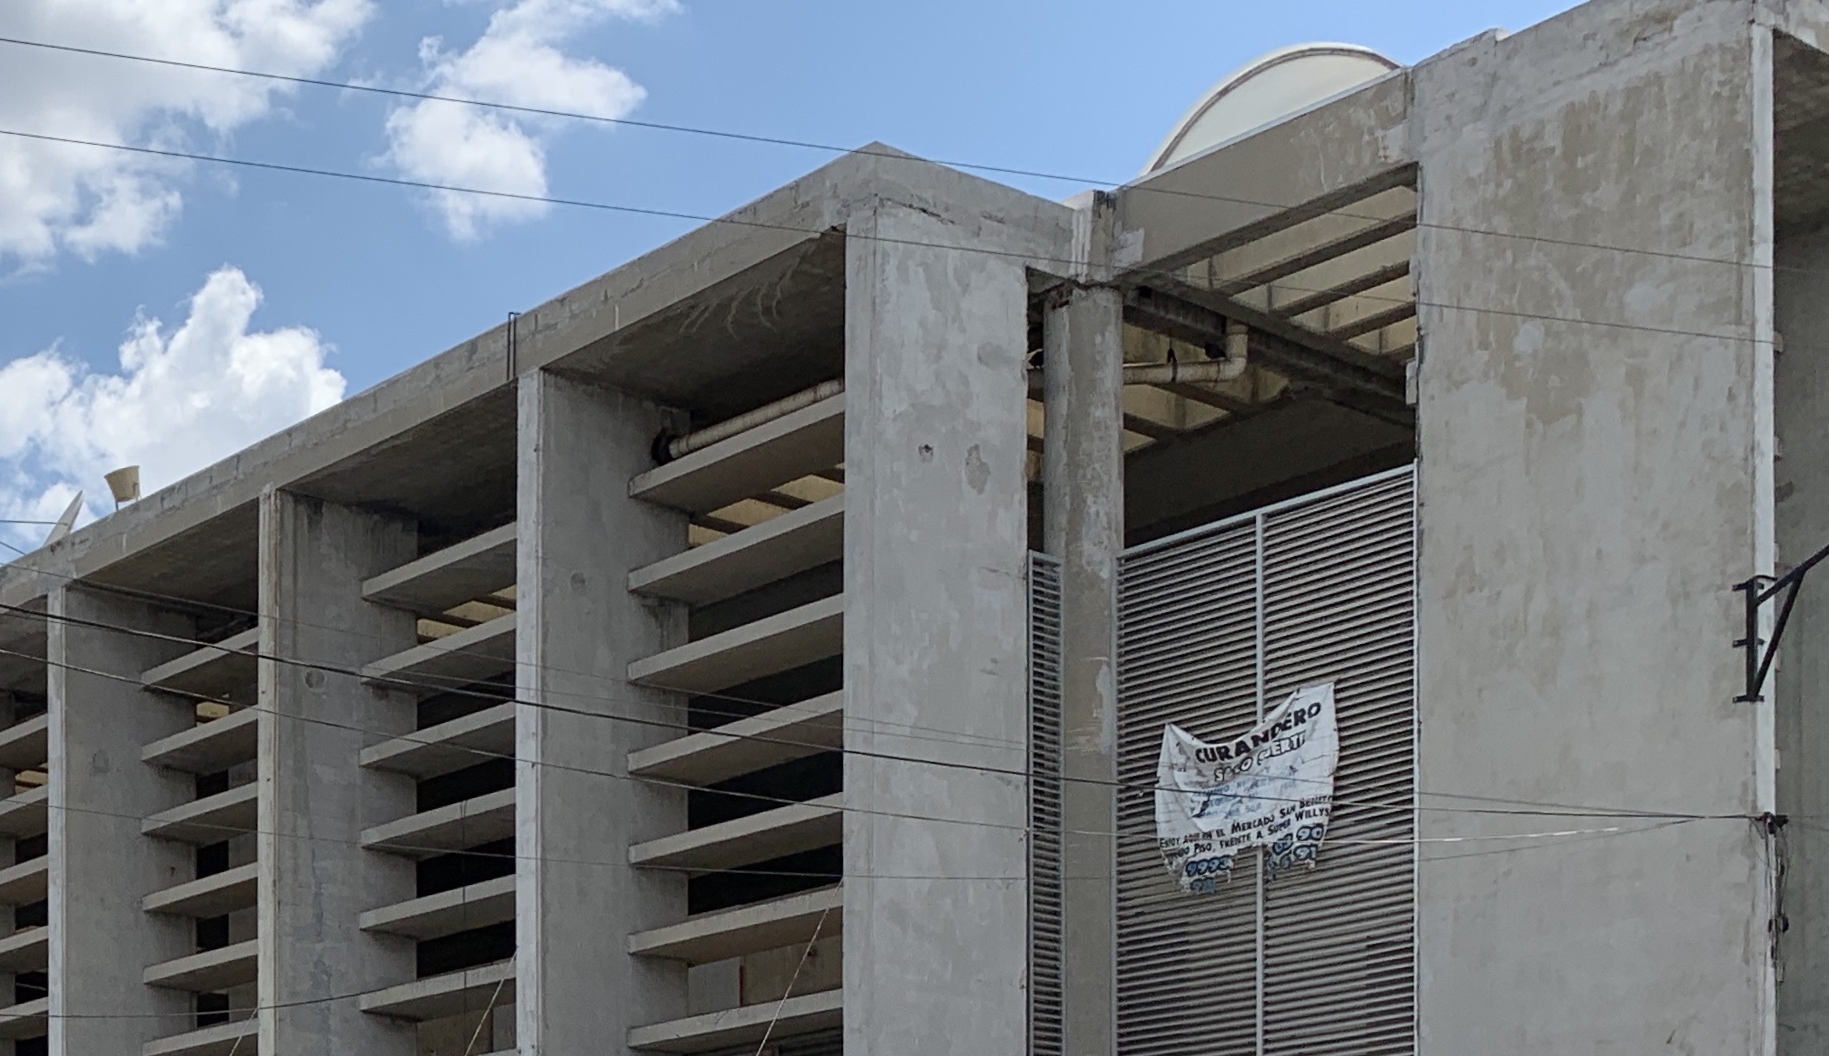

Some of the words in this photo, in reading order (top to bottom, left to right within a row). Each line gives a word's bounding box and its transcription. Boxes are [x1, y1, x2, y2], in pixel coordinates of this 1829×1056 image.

[1195, 702, 1322, 763] CURANDERO
[1231, 814, 1275, 834] MERCADO
[1279, 805, 1296, 818] SAN
[1256, 829, 1264, 840] A
[1268, 820, 1291, 836] SUPER
[1294, 808, 1330, 822] WILLYS
